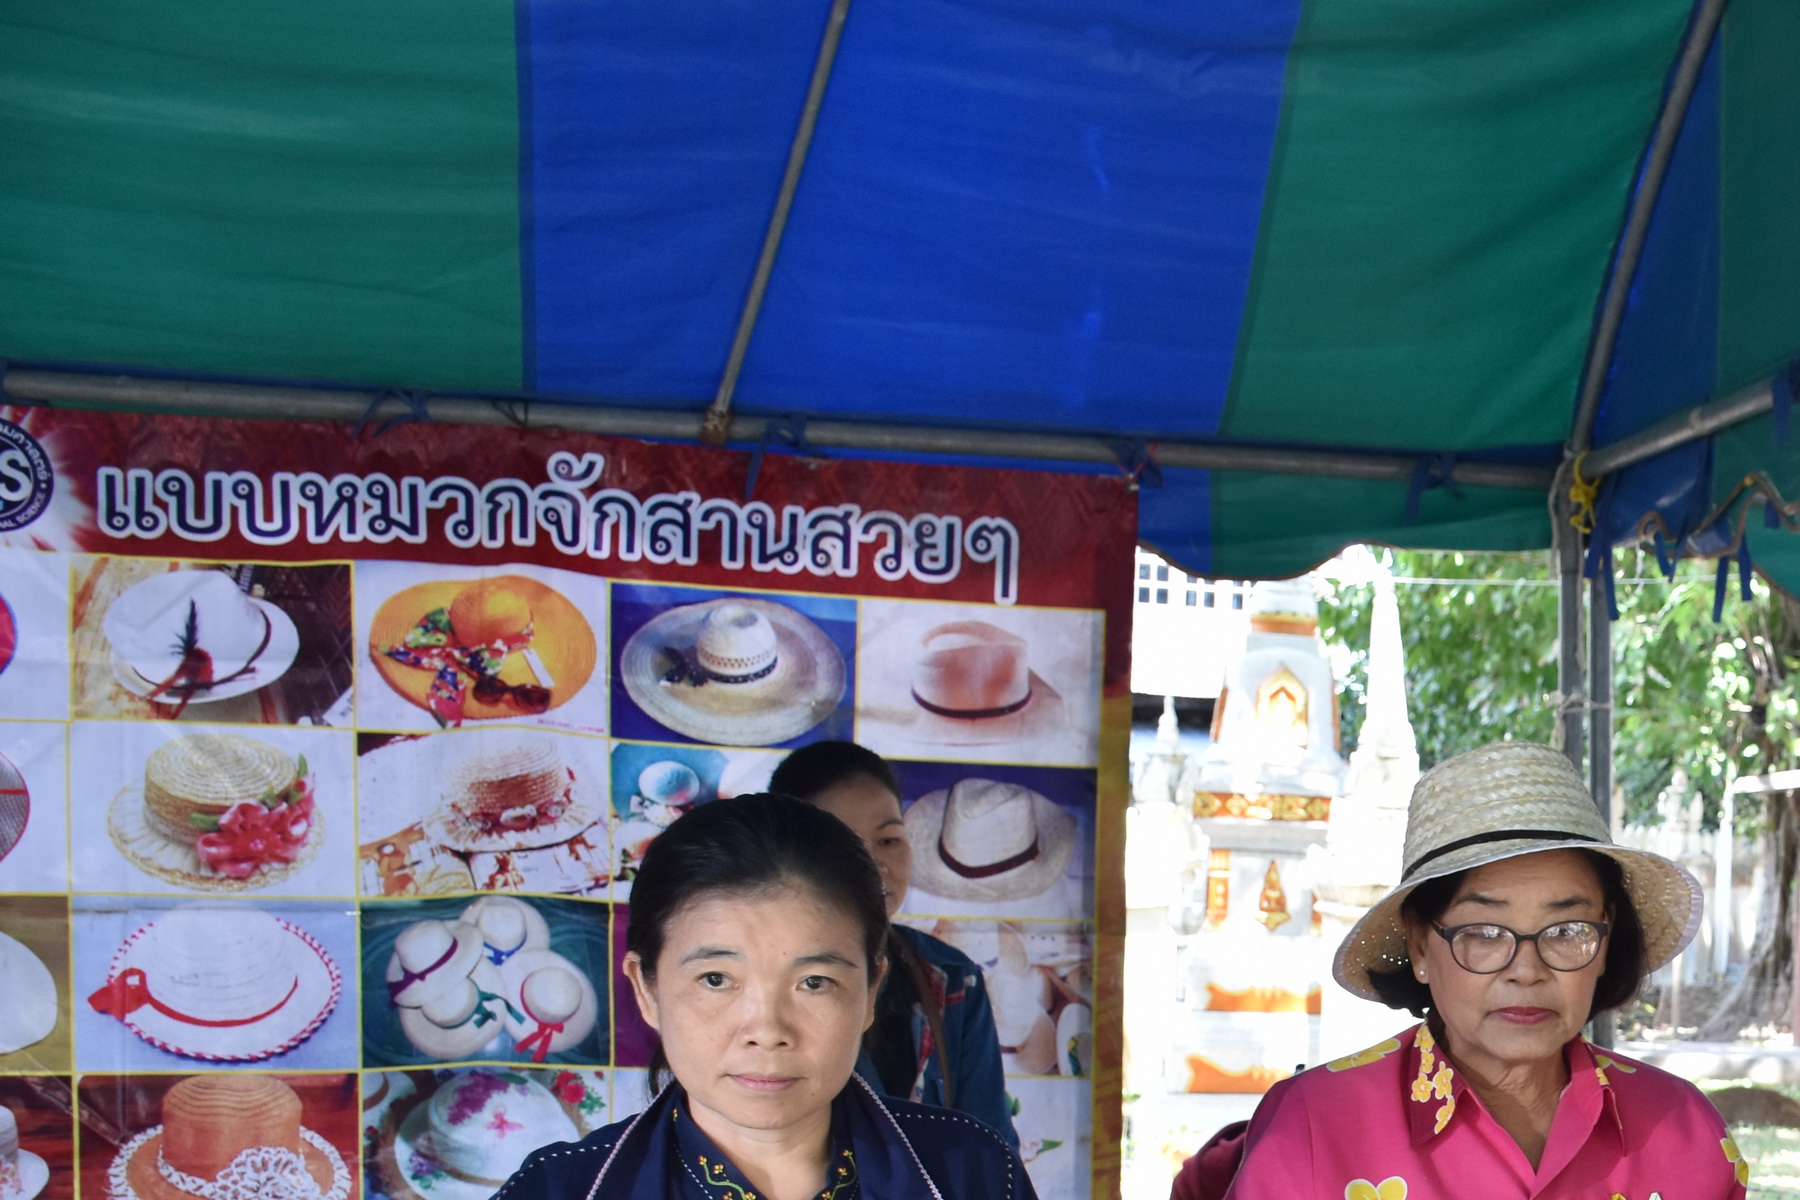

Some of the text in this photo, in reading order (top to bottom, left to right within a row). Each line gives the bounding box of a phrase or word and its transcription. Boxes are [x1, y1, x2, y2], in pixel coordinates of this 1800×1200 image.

[96, 452, 1019, 605] แบบหมวกจักสานสวยๆ
